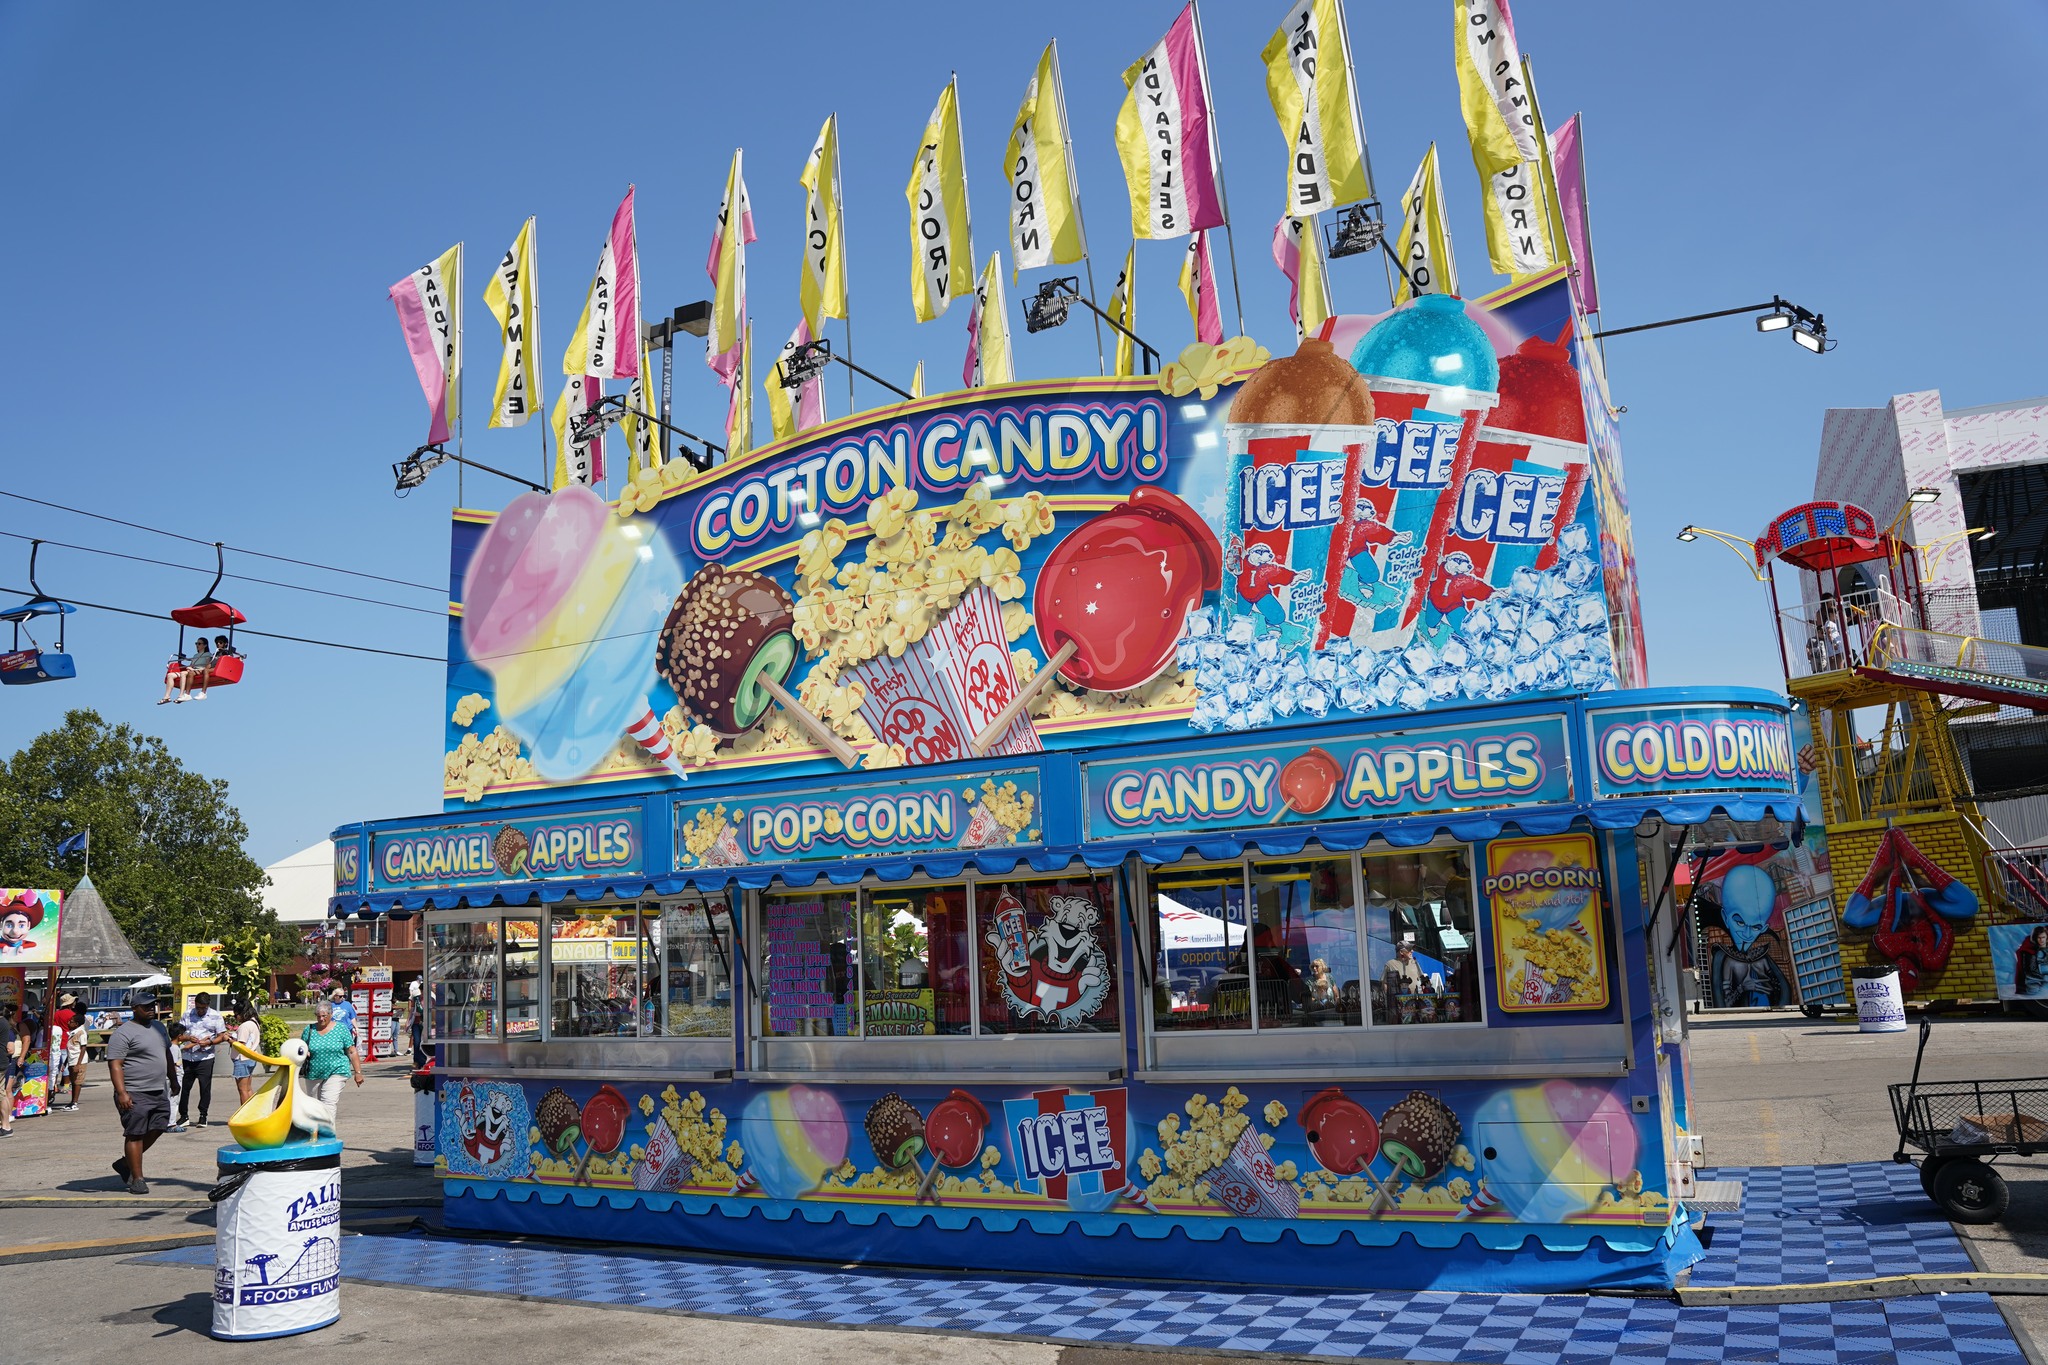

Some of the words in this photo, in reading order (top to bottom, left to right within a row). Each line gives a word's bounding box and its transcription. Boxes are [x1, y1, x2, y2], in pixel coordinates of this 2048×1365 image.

[664, 351, 672, 369] LOT
[663, 371, 671, 398] GRAY
[1360, 419, 1463, 489] CEE
[697, 431, 908, 551] COTTON
[921, 409, 1158, 482] CANDY!
[1240, 461, 1346, 530] ICEE
[1452, 469, 1566, 545] CEE
[1754, 501, 1877, 567] METRO
[1388, 547, 1427, 562] Coldest
[1393, 560, 1421, 571] Drink
[1388, 573, 1398, 582] in
[1291, 582, 1328, 601] Coldest
[1297, 594, 1323, 611] Drink
[1294, 611, 1304, 621] in
[955, 606, 978, 653] fresh
[871, 667, 907, 703] fresh
[968, 659, 989, 712] POP
[983, 663, 1010, 726] CORN
[885, 708, 925, 748] POP
[905, 720, 957, 766] CORN
[1605, 725, 1711, 778] COLD
[1112, 765, 1275, 820] CANDY
[1349, 738, 1539, 801] APPLES
[752, 807, 824, 850] POP
[845, 794, 951, 842] CORN
[384, 836, 495, 877] CARAMEL
[531, 824, 631, 867] APPLES
[1485, 870, 1601, 896] POPCORN!
[767, 904, 799, 916] COTTON
[800, 902, 824, 915] CANDY
[1195, 898, 1259, 921] mobie
[768, 917, 805, 929] POPCORN
[1002, 917, 1024, 939] ICEE
[552, 943, 604, 957] ONADE
[769, 943, 793, 954] CANDY
[795, 942, 820, 953] APPLE
[769, 955, 803, 967] CARAMEL
[805, 954, 830, 966] APPLE
[769, 968, 804, 980] CARAMEL
[805, 967, 827, 979] CORN
[769, 981, 793, 993] SMALL
[794, 980, 820, 992] DRINK
[865, 990, 885, 1001] Fresh
[885, 989, 922, 1001] Squeezed
[1526, 980, 1539, 992] POP
[1856, 982, 1889, 994] TALLEY
[770, 993, 807, 1005] SOUVENIR
[808, 992, 834, 1005] DRINK
[770, 1006, 807, 1018] SOUVENIR
[809, 1006, 834, 1018] REFILL
[771, 1020, 797, 1032] WATER
[650, 1141, 662, 1157] POP
[1017, 1107, 1114, 1180] ICEE
[645, 1152, 662, 1172] CORN
[1253, 1159, 1265, 1181] POP
[1223, 1185, 1242, 1205] POP
[1236, 1187, 1259, 1213] CORN
[254, 1287, 299, 1304] FOOD
[311, 1278, 334, 1296] FUN
